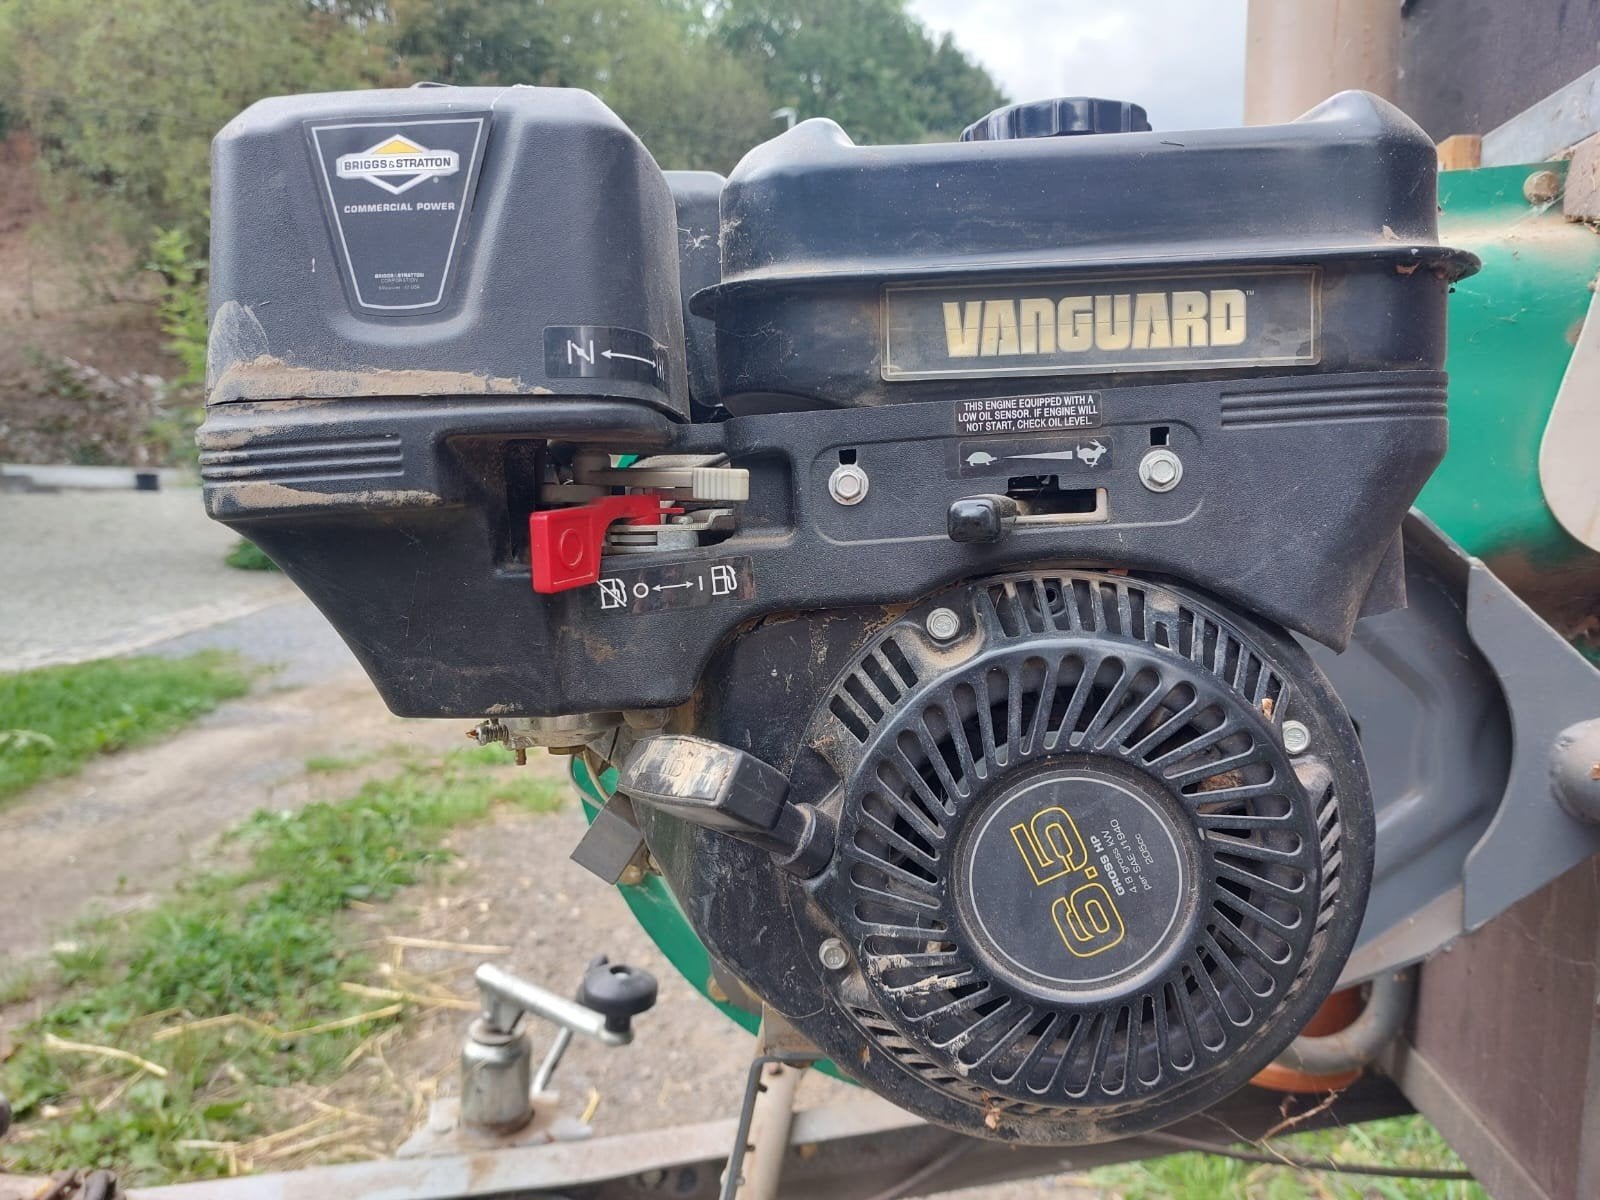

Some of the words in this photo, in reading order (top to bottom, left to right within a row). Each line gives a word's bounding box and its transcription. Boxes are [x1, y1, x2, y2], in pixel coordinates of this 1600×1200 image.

[344, 203, 413, 213] COMMERCIAL
[416, 202, 455, 211] POWER
[943, 289, 1247, 358] VANGUARD
[964, 401, 983, 411] THIS
[985, 399, 1017, 410] ENGINE
[1018, 396, 1062, 409] EQUIPPED
[1063, 395, 1085, 406] WITH
[1086, 395, 1094, 404] A
[958, 412, 977, 422] LOW
[978, 411, 993, 421] OIL
[994, 409, 1032, 420] SENSOR.
[1034, 408, 1041, 417] IF
[1043, 406, 1076, 417] ENGINE
[1077, 405, 1099, 415] WILL
[966, 422, 983, 432] NOT
[985, 420, 1015, 431] START,
[1017, 418, 1047, 429] CHECK
[1048, 417, 1062, 427] OIL
[1064, 416, 1092, 426] LEVEL.
[1090, 835, 1104, 853] HP
[1101, 830, 1115, 847] kW
[1110, 819, 1132, 851] J1940
[1135, 833, 1154, 865] 205cc
[1113, 848, 1130, 874] gross
[1127, 853, 1142, 873] SAE
[1010, 807, 1125, 957] 6.5
[1100, 854, 1125, 896] GROSS
[1138, 875, 1152, 891] per
[1124, 876, 1137, 893] 4.8
